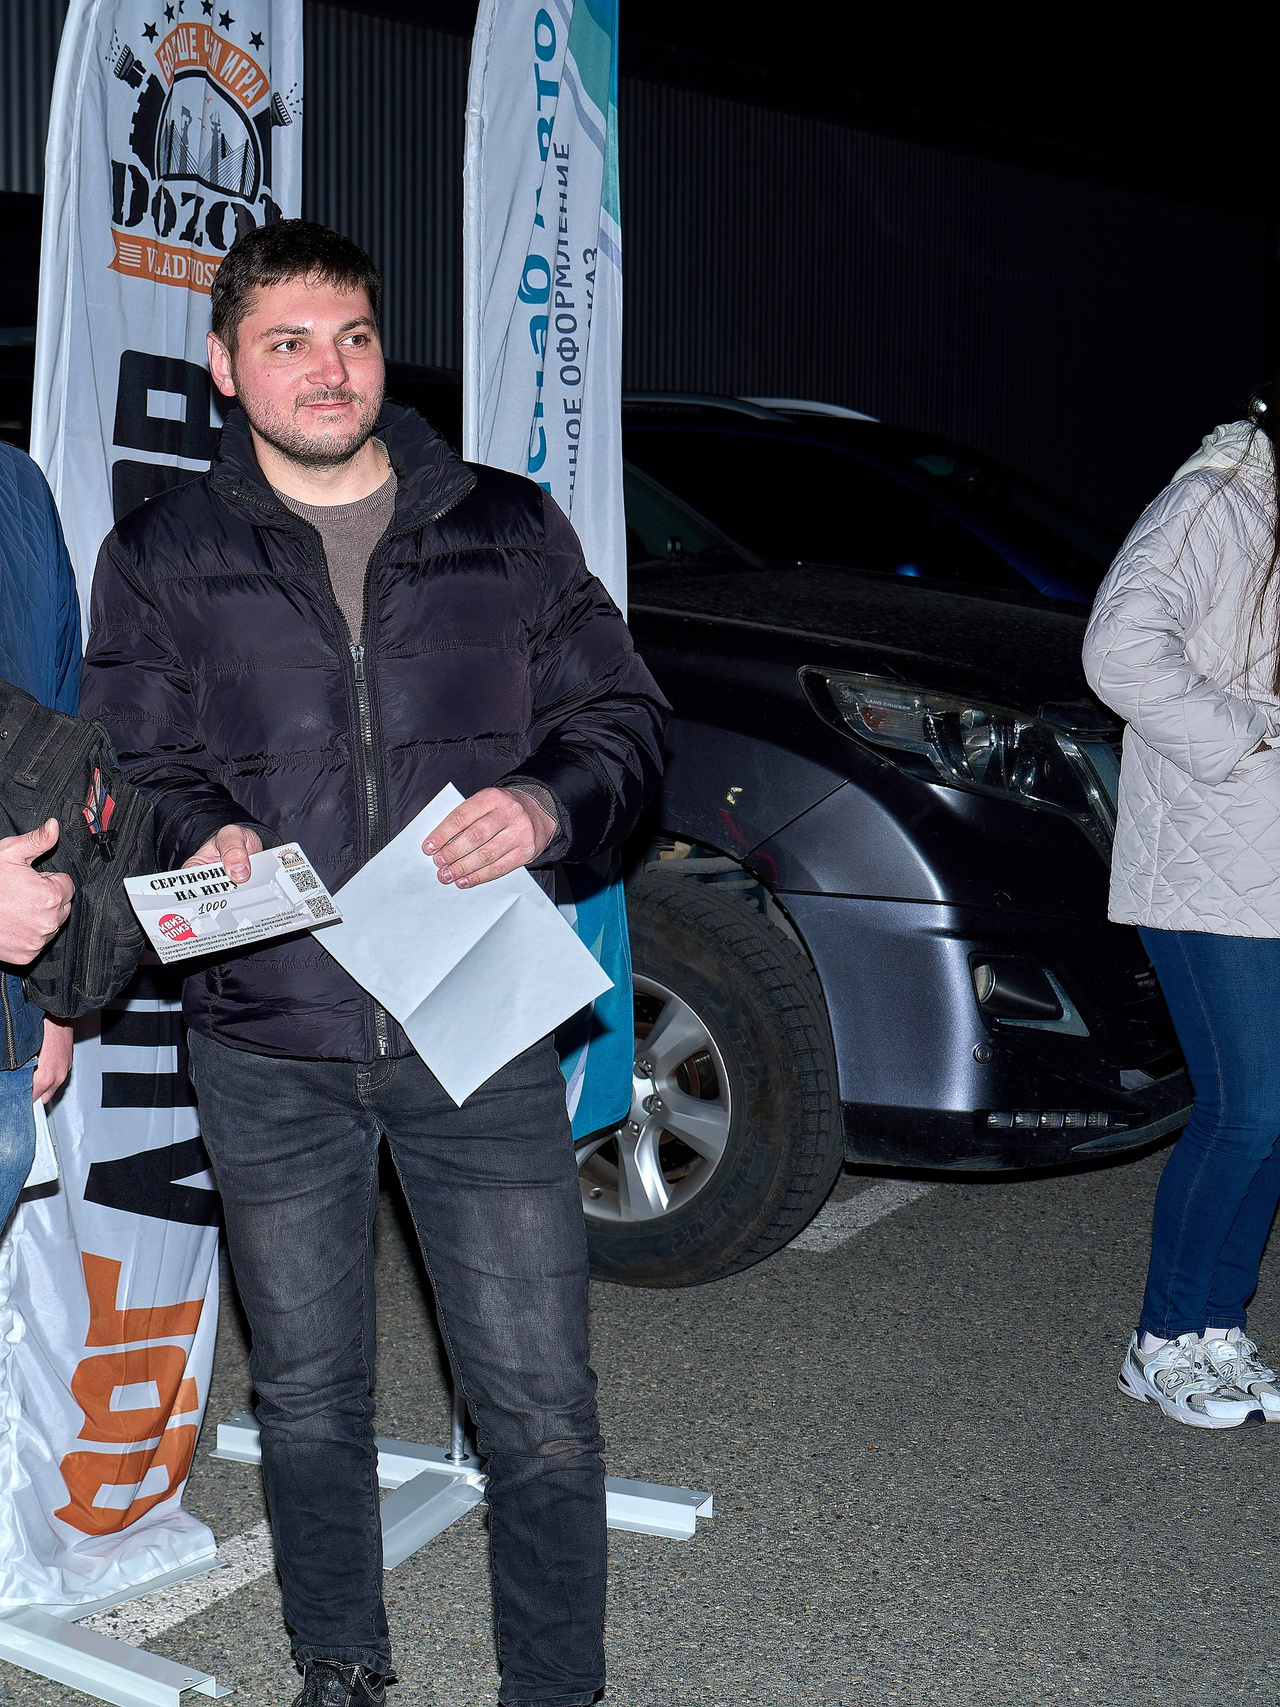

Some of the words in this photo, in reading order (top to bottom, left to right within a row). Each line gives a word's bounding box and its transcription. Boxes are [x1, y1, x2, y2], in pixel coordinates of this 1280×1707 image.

[219, 50, 264, 104] ИГРА
[146, 246, 222, 288] VLADIVOS
[149, 866, 227, 891] СЕРТИФИ
[174, 889, 198, 902] НА
[198, 898, 228, 915] 1000
